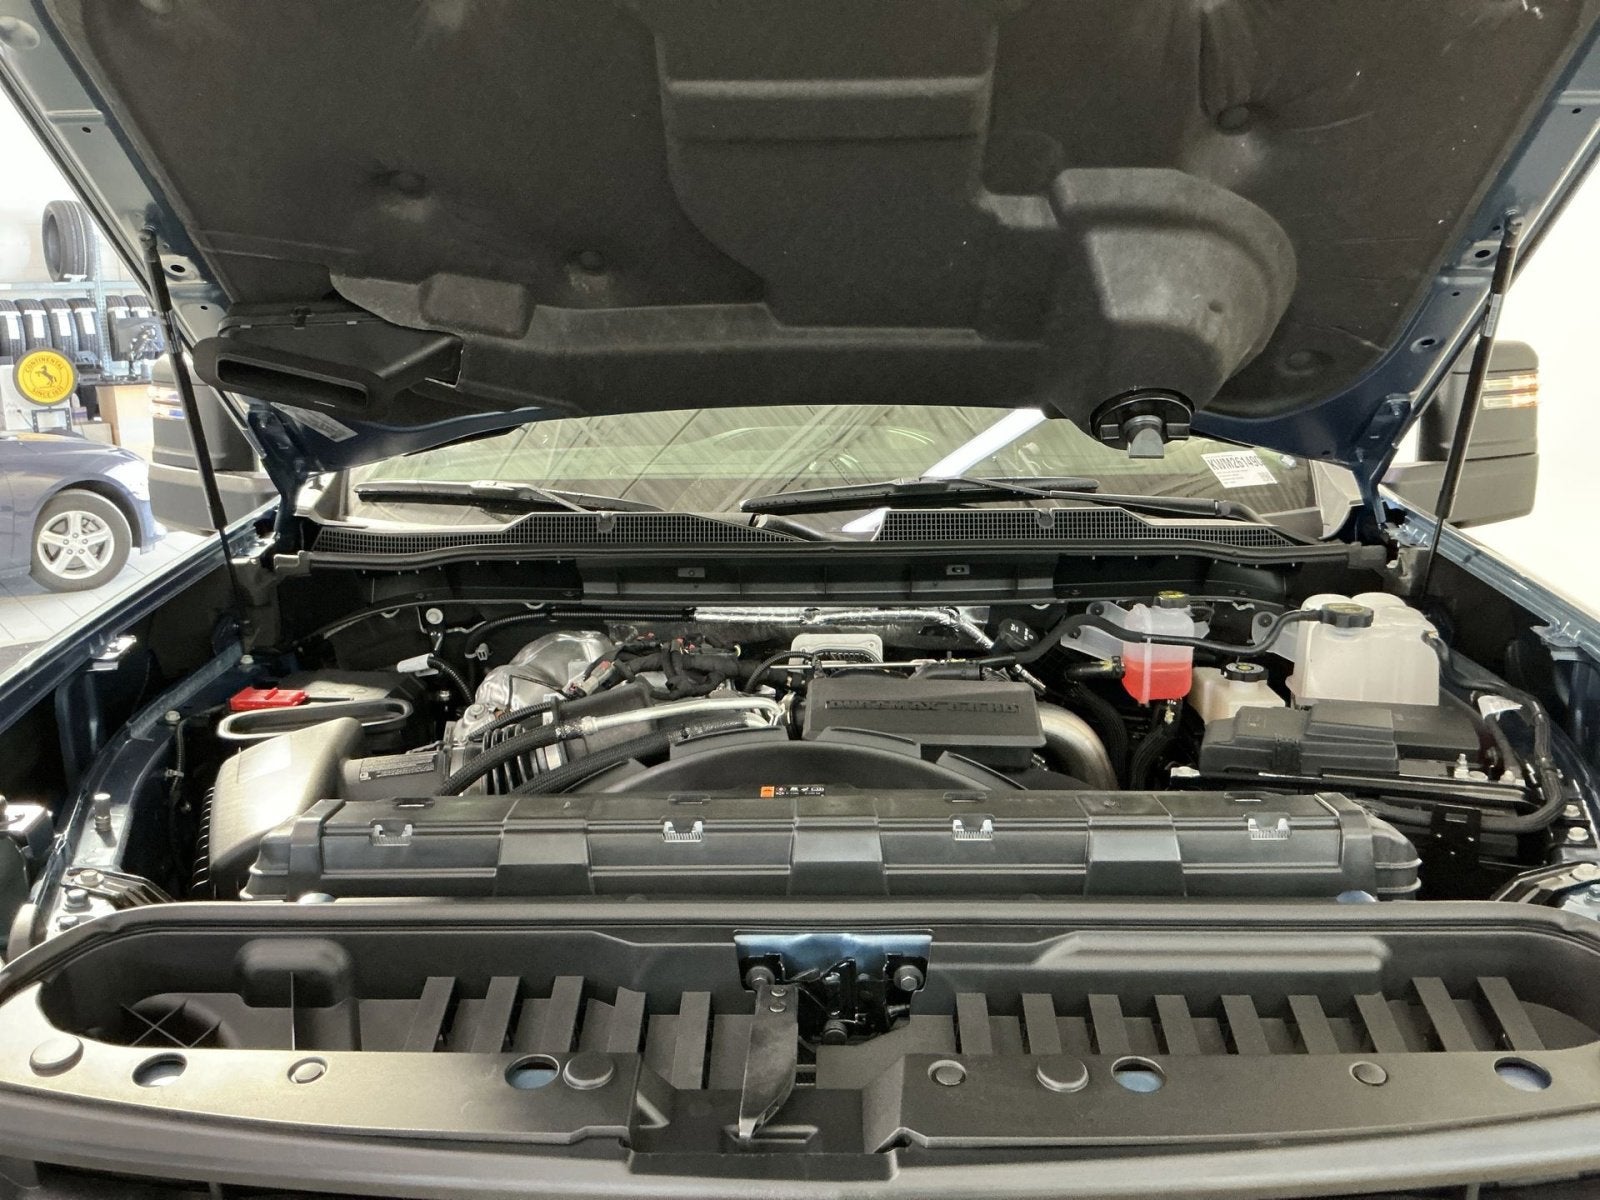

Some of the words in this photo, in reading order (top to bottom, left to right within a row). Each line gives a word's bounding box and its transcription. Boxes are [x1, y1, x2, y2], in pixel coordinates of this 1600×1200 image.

[25, 356, 64, 373] CONTINENTAL
[32, 387, 51, 398] SINCE
[1207, 455, 1265, 471] KWM261490
